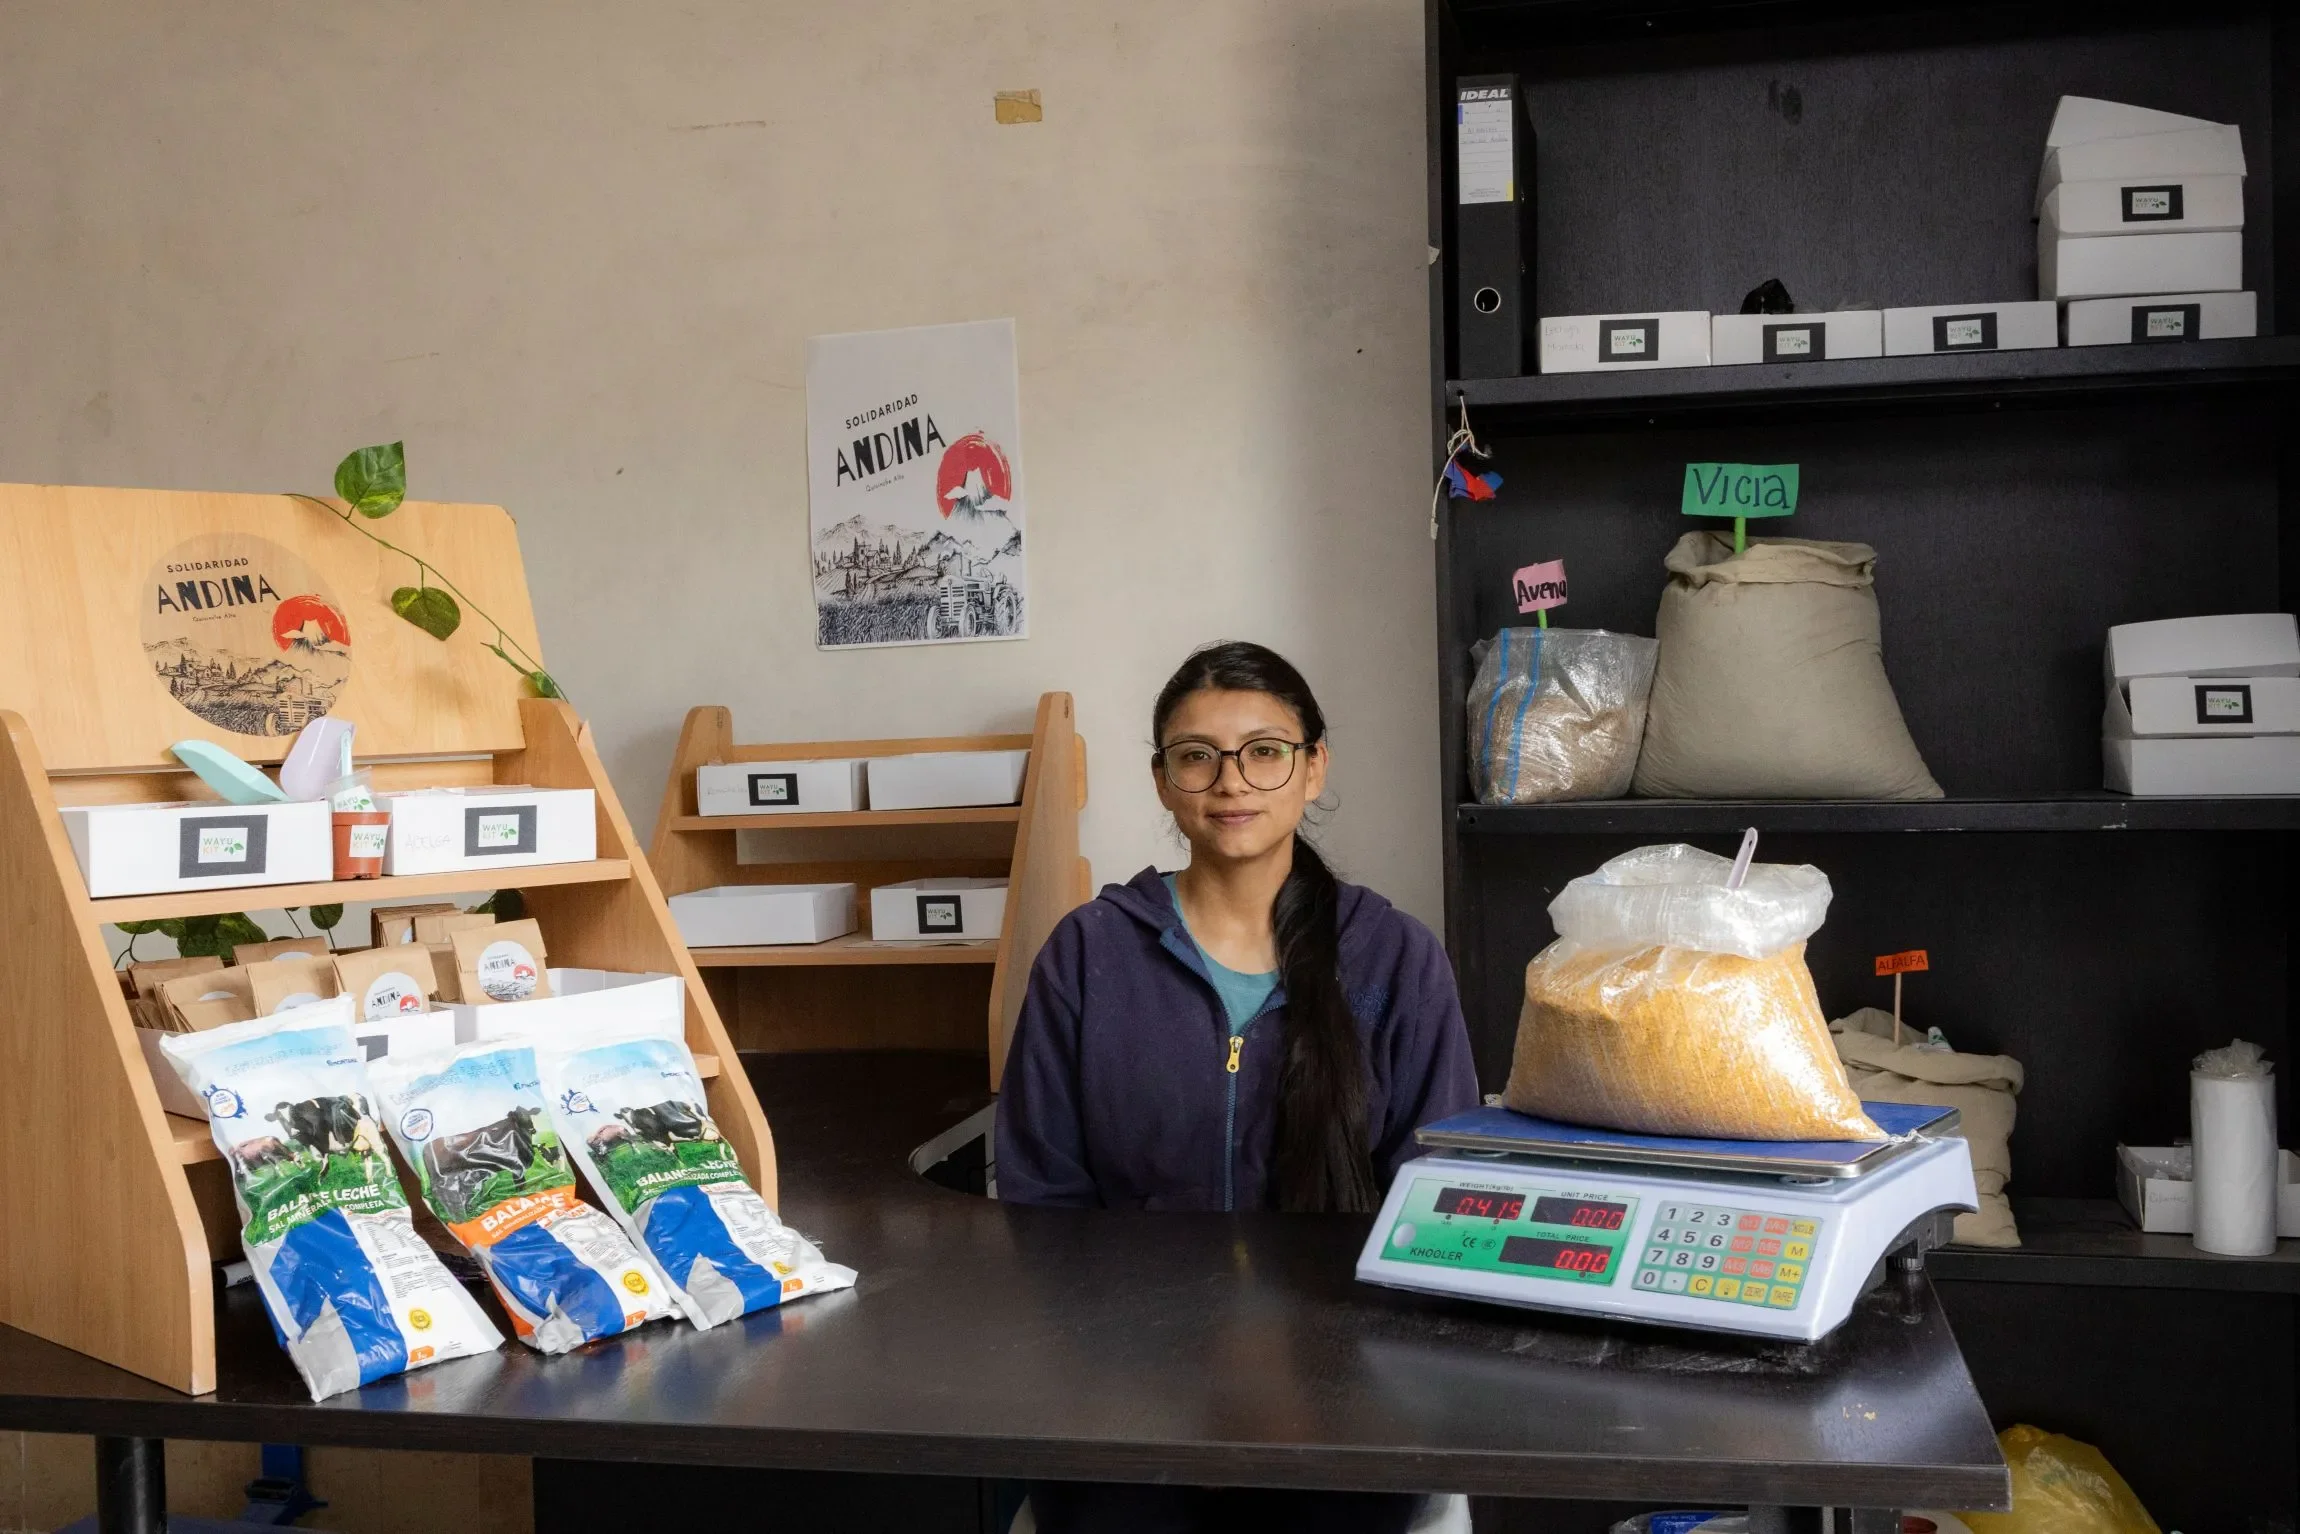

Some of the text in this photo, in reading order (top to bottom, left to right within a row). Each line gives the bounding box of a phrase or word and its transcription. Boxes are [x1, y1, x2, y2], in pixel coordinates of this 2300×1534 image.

[1461, 88, 1508, 101] IDEAL
[845, 394, 918, 430] SOLIDARIDAD
[837, 413, 946, 487] ANDINA
[167, 557, 249, 573] SOLIDARIDAD
[158, 573, 281, 614] ANDINA
[482, 823, 508, 832] WAYU
[203, 837, 233, 846] WAYU
[353, 832, 380, 841] WAYU
[484, 958, 515, 973] ANDINA
[1878, 955, 1926, 970] ALFALFA
[372, 991, 401, 1008] ANDINA
[333, 1184, 381, 1201] LECHE
[1668, 1208, 1677, 1220] 1
[1690, 1211, 1705, 1223] 2
[1717, 1214, 1731, 1226] 3
[268, 1221, 285, 1234] SAL
[1536, 1231, 1591, 1242] TOTAL PRICE
[1658, 1229, 1670, 1241] 4
[1683, 1231, 1697, 1244] 5
[1710, 1235, 1723, 1247] 6
[1791, 1246, 1803, 1257] M
[1409, 1247, 1463, 1261] KHOOLER
[1651, 1250, 1663, 1262] 7
[1676, 1253, 1689, 1266] 8
[1702, 1256, 1715, 1268] 9
[1779, 1267, 1800, 1278] M+
[1643, 1272, 1656, 1284] 0
[1695, 1279, 1707, 1291] C
